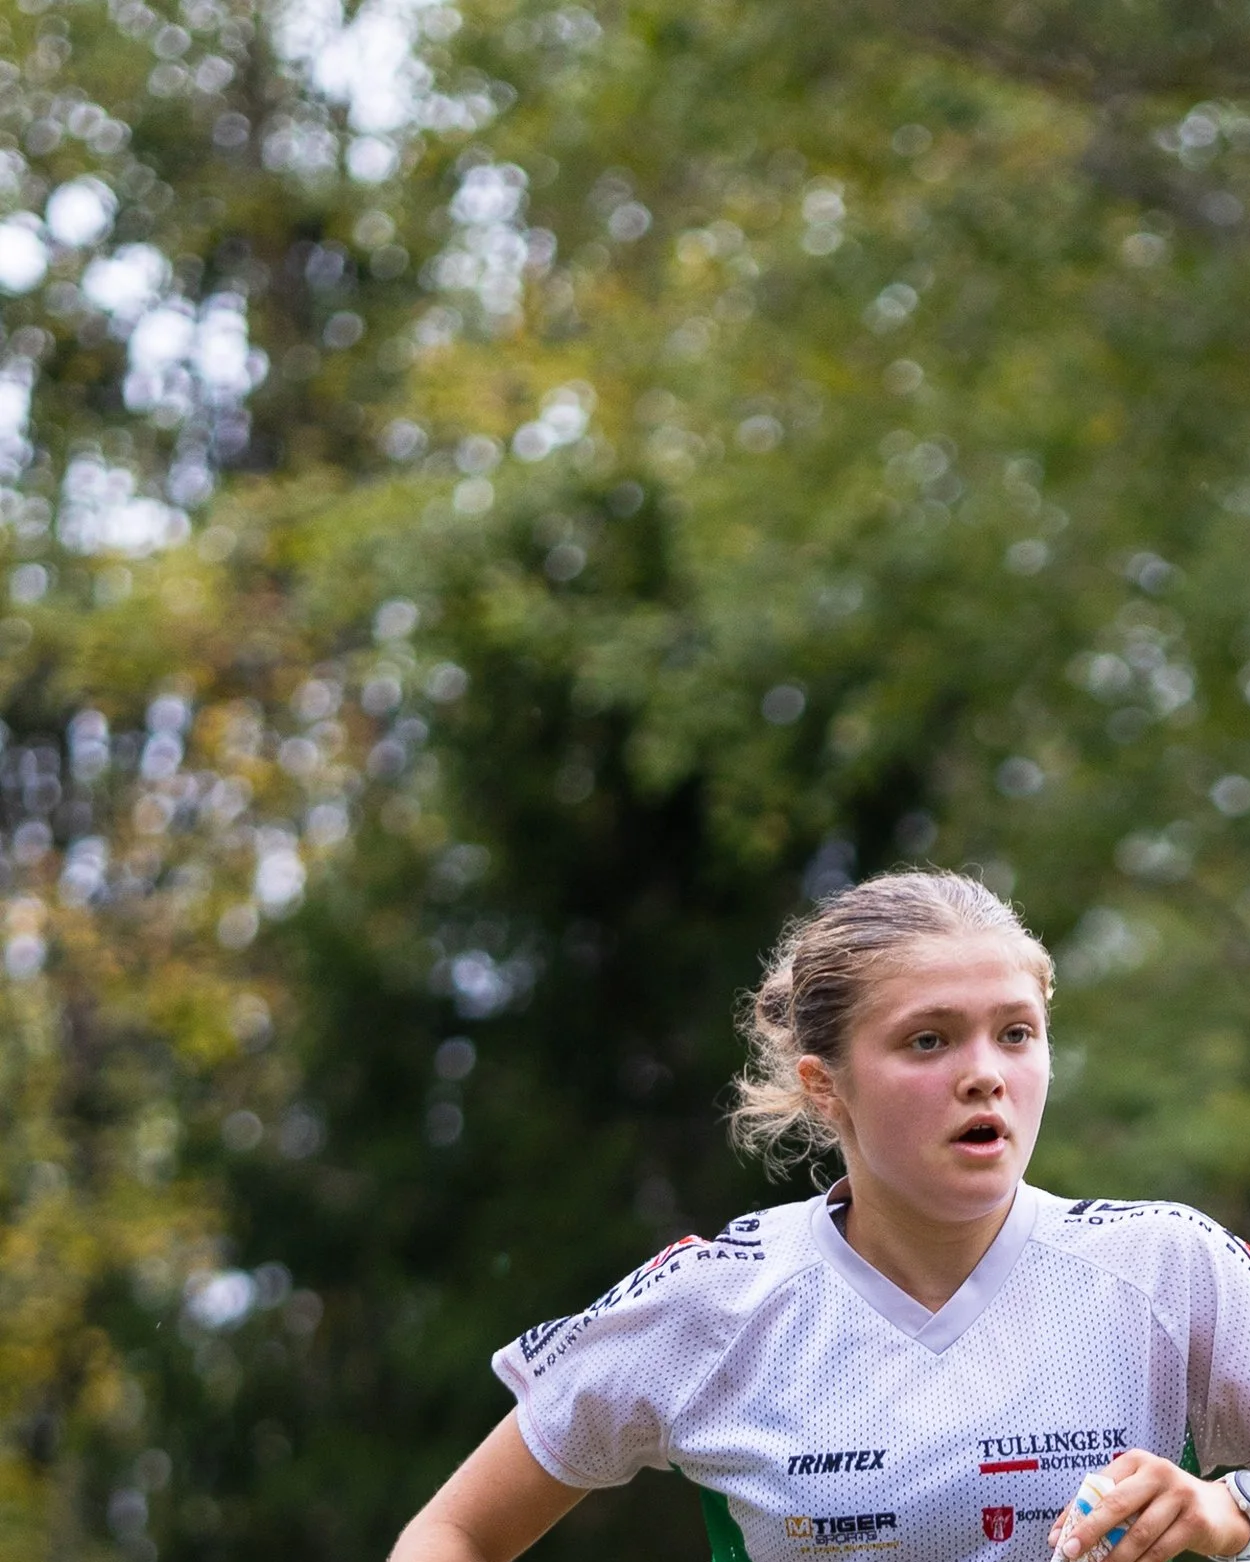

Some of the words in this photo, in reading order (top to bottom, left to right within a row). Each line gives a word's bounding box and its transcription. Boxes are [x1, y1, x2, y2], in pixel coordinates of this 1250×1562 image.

[633, 1260, 681, 1298] BIKE
[697, 1250, 766, 1261] RACE
[979, 1429, 1100, 1458] TULLINGE
[1102, 1427, 1128, 1449] SK
[787, 1449, 886, 1476] TRIMTEX
[1041, 1453, 1111, 1471] BOTKYRKA
